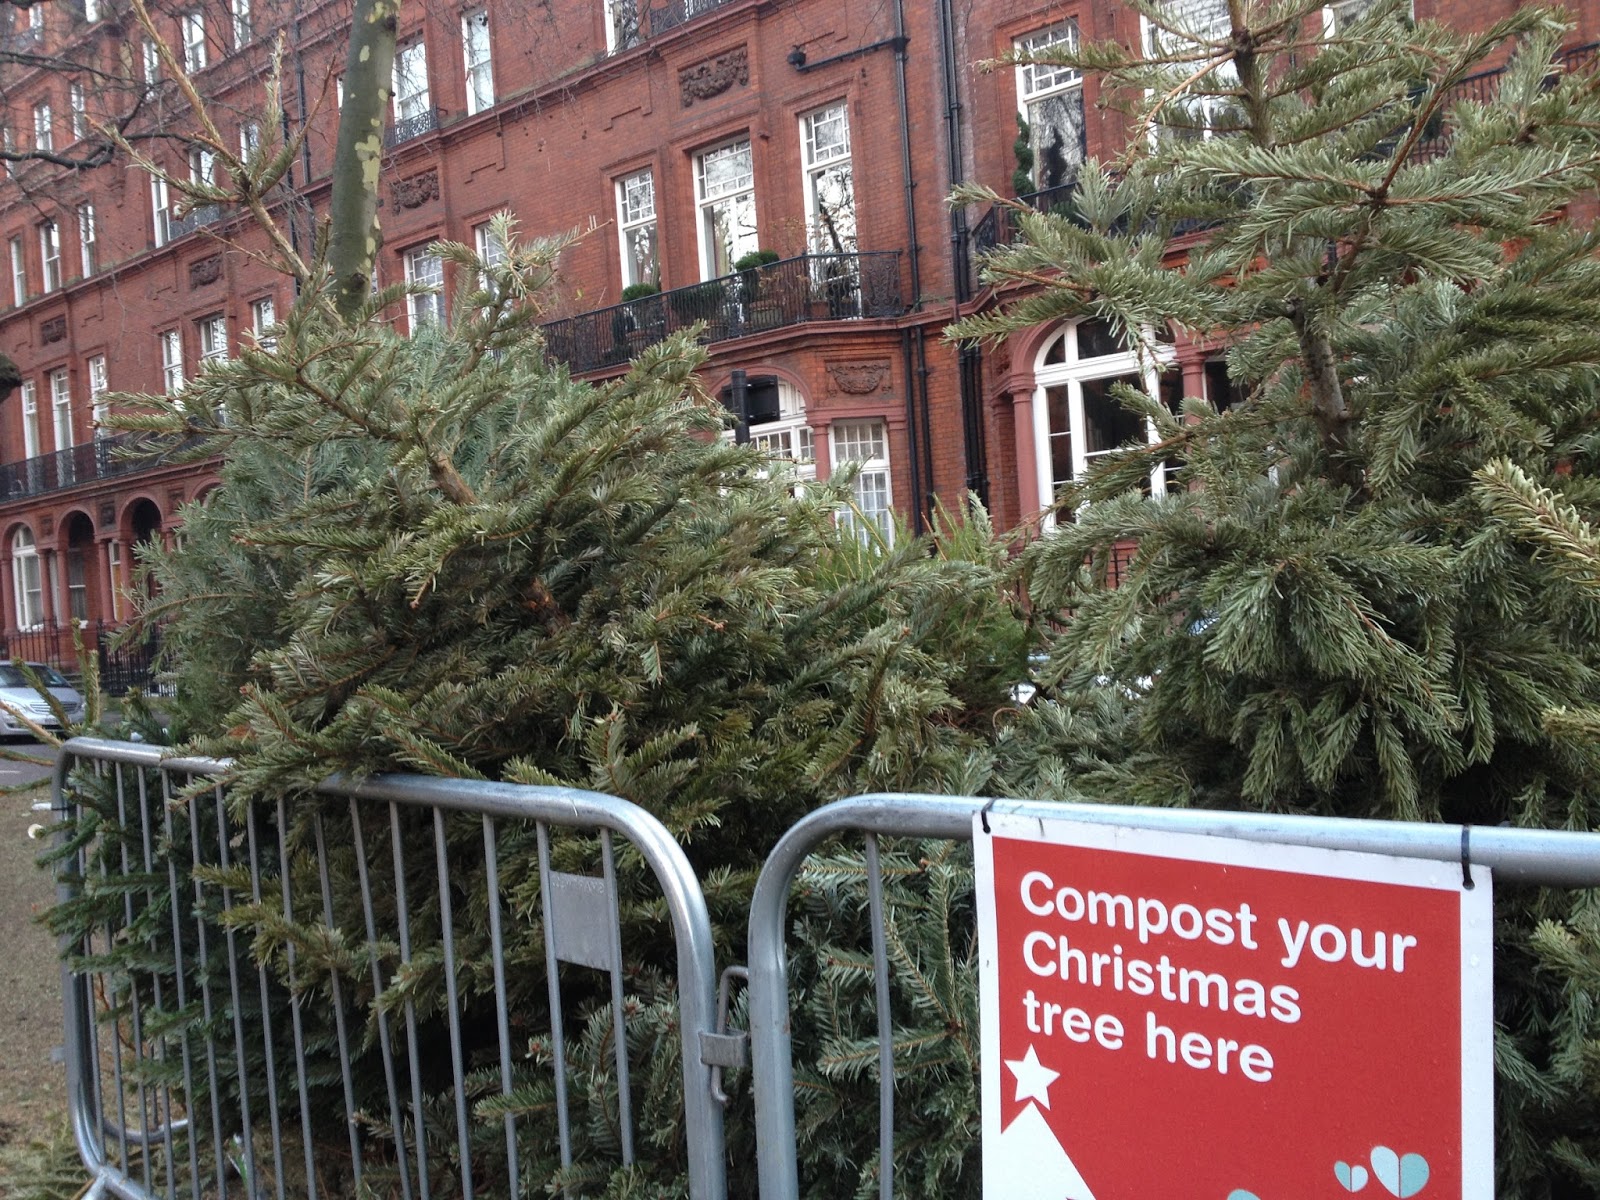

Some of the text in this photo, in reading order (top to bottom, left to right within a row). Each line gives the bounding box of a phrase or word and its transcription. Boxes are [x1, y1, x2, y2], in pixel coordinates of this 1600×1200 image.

[1020, 870, 1418, 973] Compost your
[1022, 930, 1302, 1024] Christmas
[1022, 989, 1274, 1083] tree here
